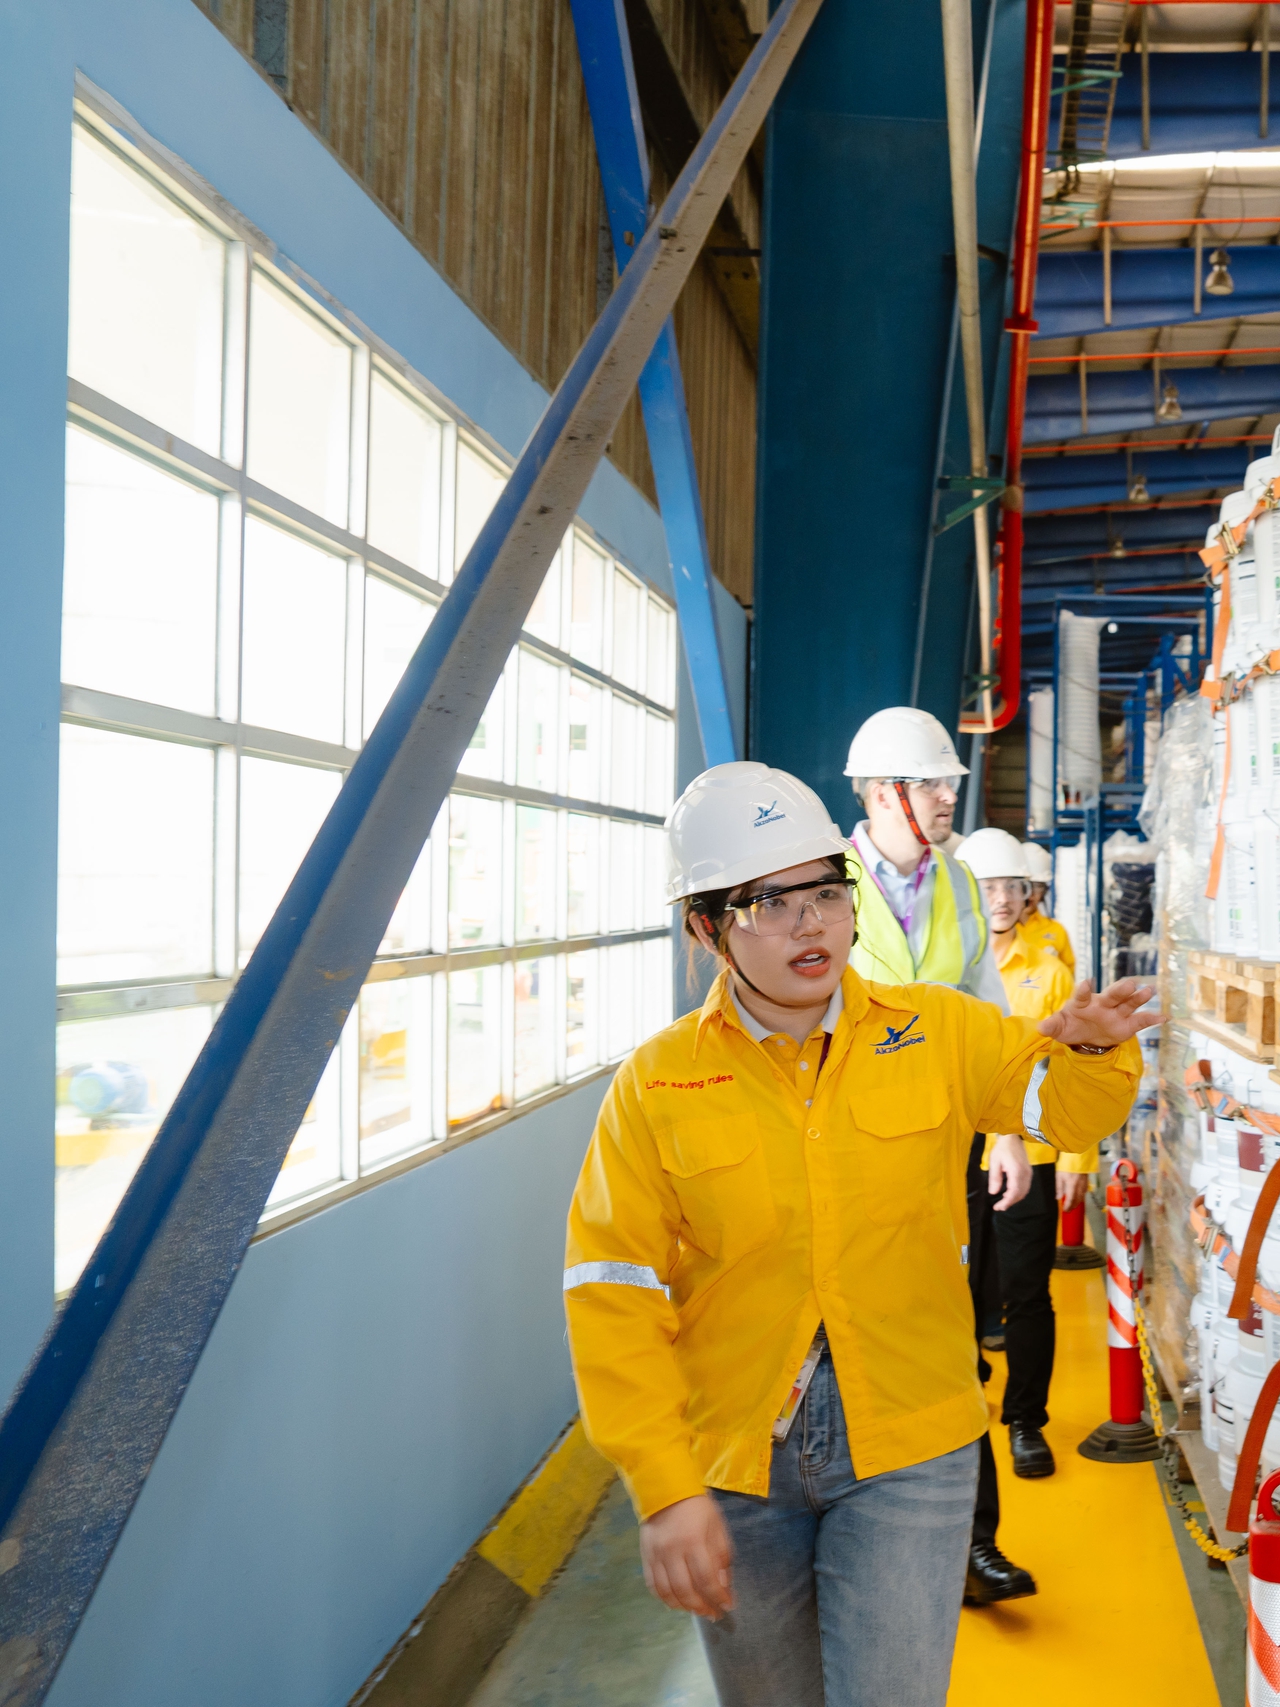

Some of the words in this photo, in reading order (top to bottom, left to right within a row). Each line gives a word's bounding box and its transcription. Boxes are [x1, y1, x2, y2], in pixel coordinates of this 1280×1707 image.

[753, 813, 786, 828] AkzoNobel
[874, 1034, 926, 1056] AkzoNobel
[646, 1079, 667, 1090] Life
[671, 1080, 705, 1091] saving
[707, 1072, 734, 1086] rules
